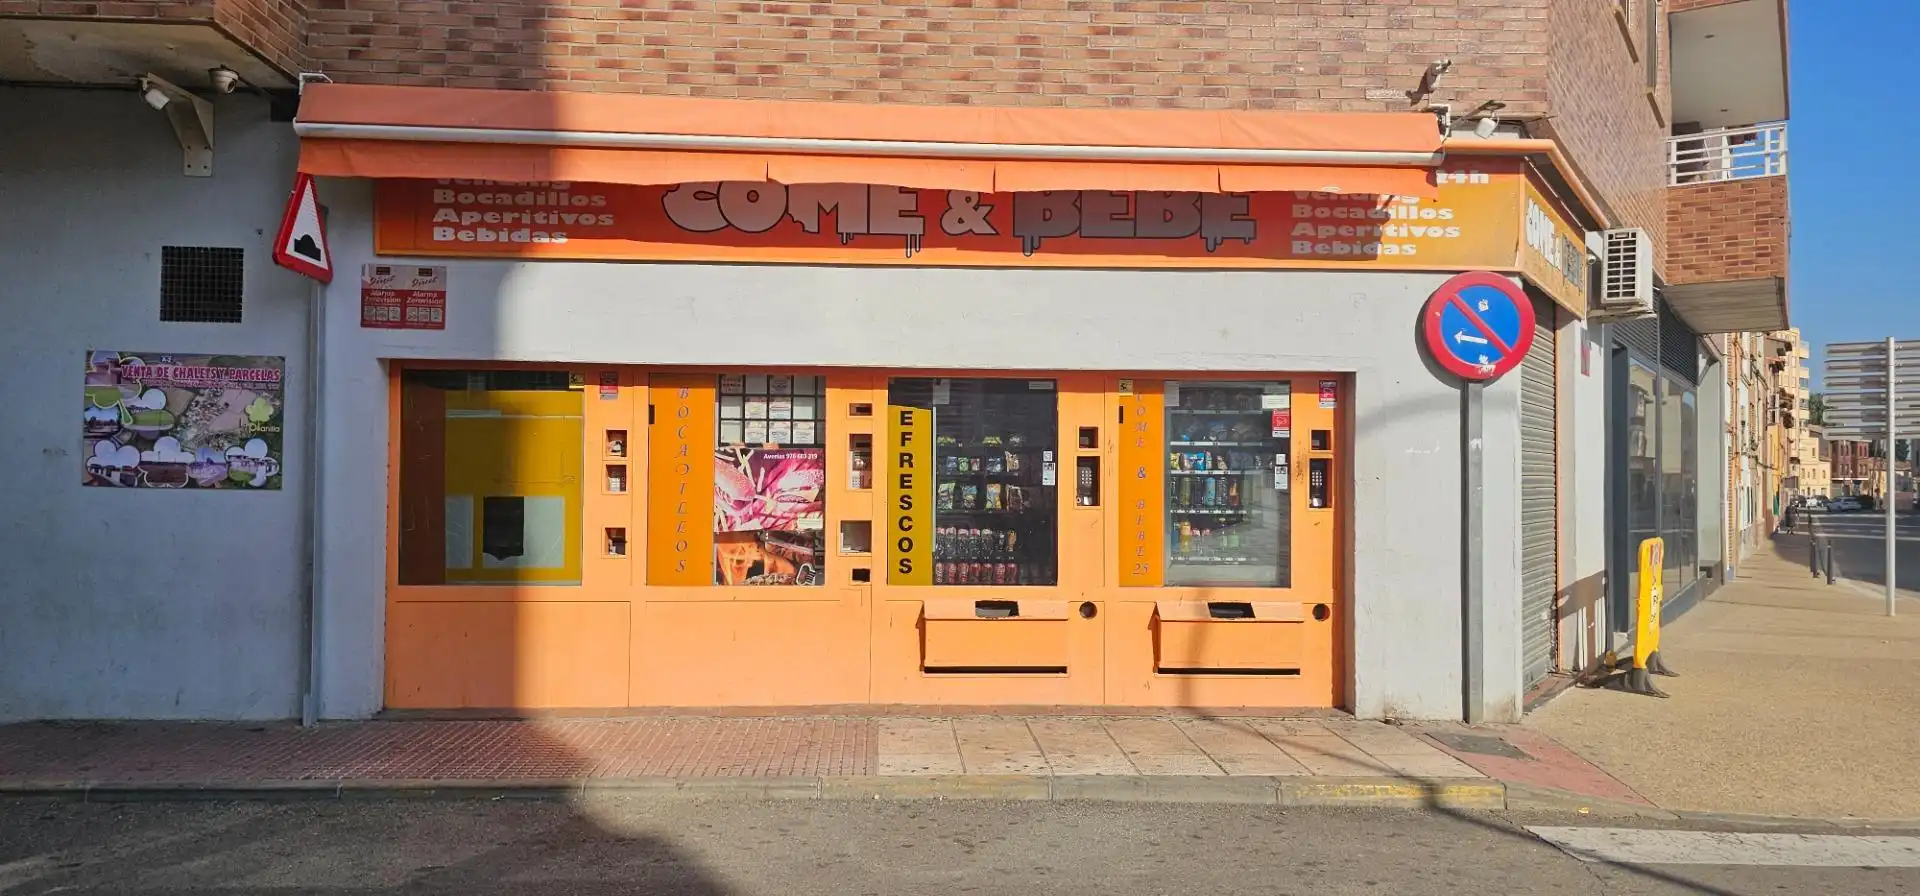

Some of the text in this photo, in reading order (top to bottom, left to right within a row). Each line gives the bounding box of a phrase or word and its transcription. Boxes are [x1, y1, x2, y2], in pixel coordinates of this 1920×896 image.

[433, 188, 607, 207] Bocadillos
[433, 208, 614, 226] Aperitivos
[661, 181, 1256, 258] COME & BEBE
[1292, 204, 1454, 220] Bocadillos
[433, 226, 568, 244] Bebidas
[1291, 222, 1461, 238] Aperitivos
[1291, 240, 1417, 256] Bebidas
[121, 365, 153, 378] VENTA
[156, 366, 170, 378] DE
[229, 368, 281, 382] PARCELAS
[1137, 467, 1147, 479] &
[898, 410, 913, 574] EFRESCOS
